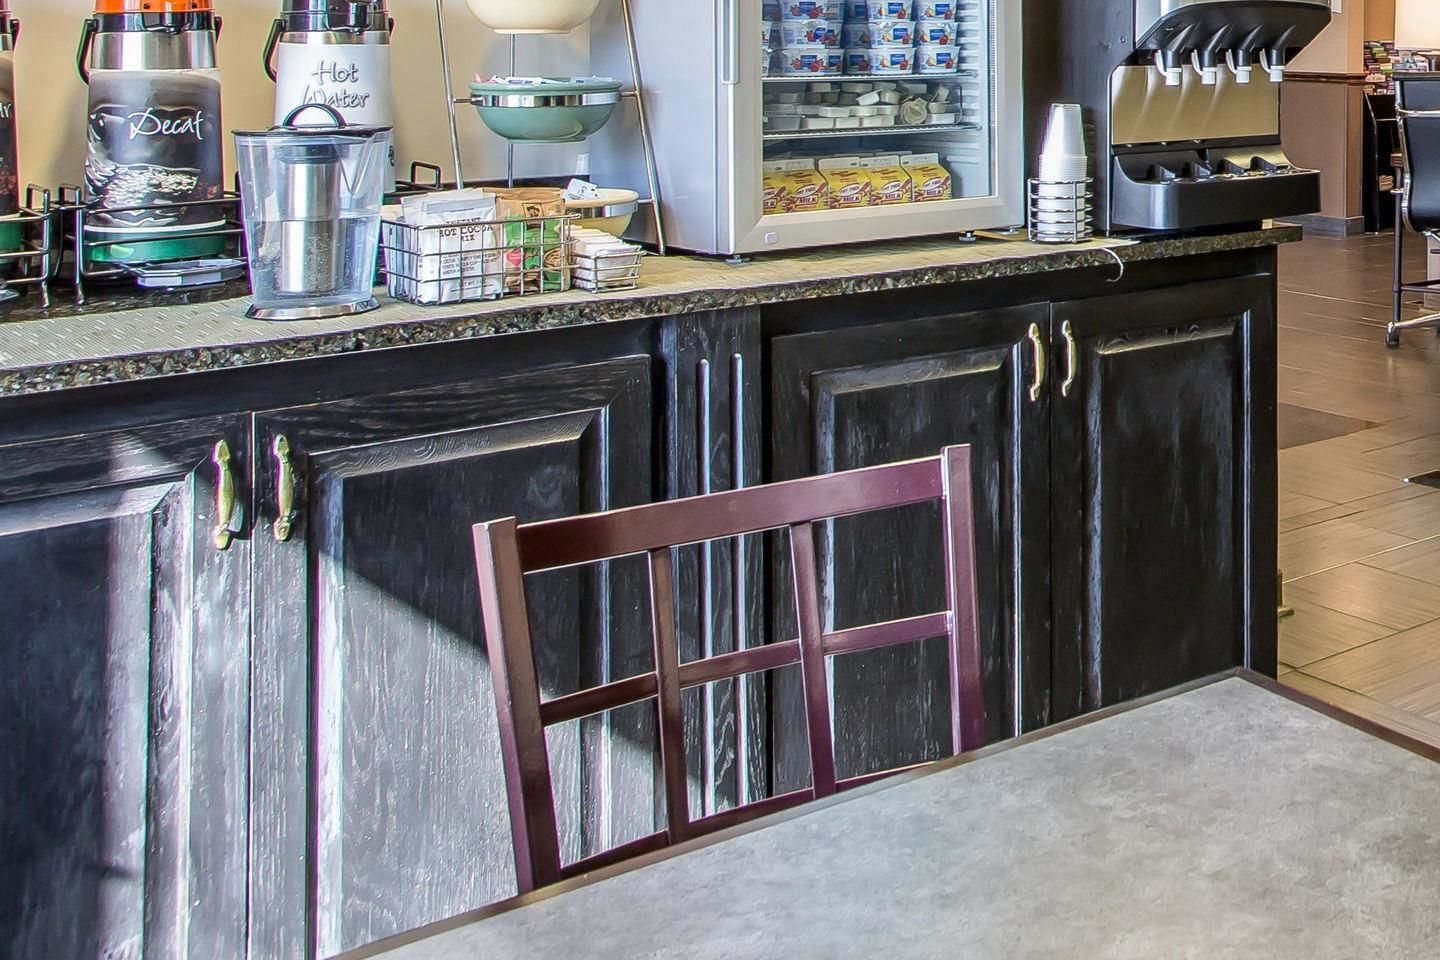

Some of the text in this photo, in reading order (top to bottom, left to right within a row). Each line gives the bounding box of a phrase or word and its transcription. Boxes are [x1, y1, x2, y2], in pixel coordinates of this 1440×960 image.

[311, 60, 360, 85] Hot
[302, 84, 371, 108] Water
[127, 107, 204, 140] Decaf
